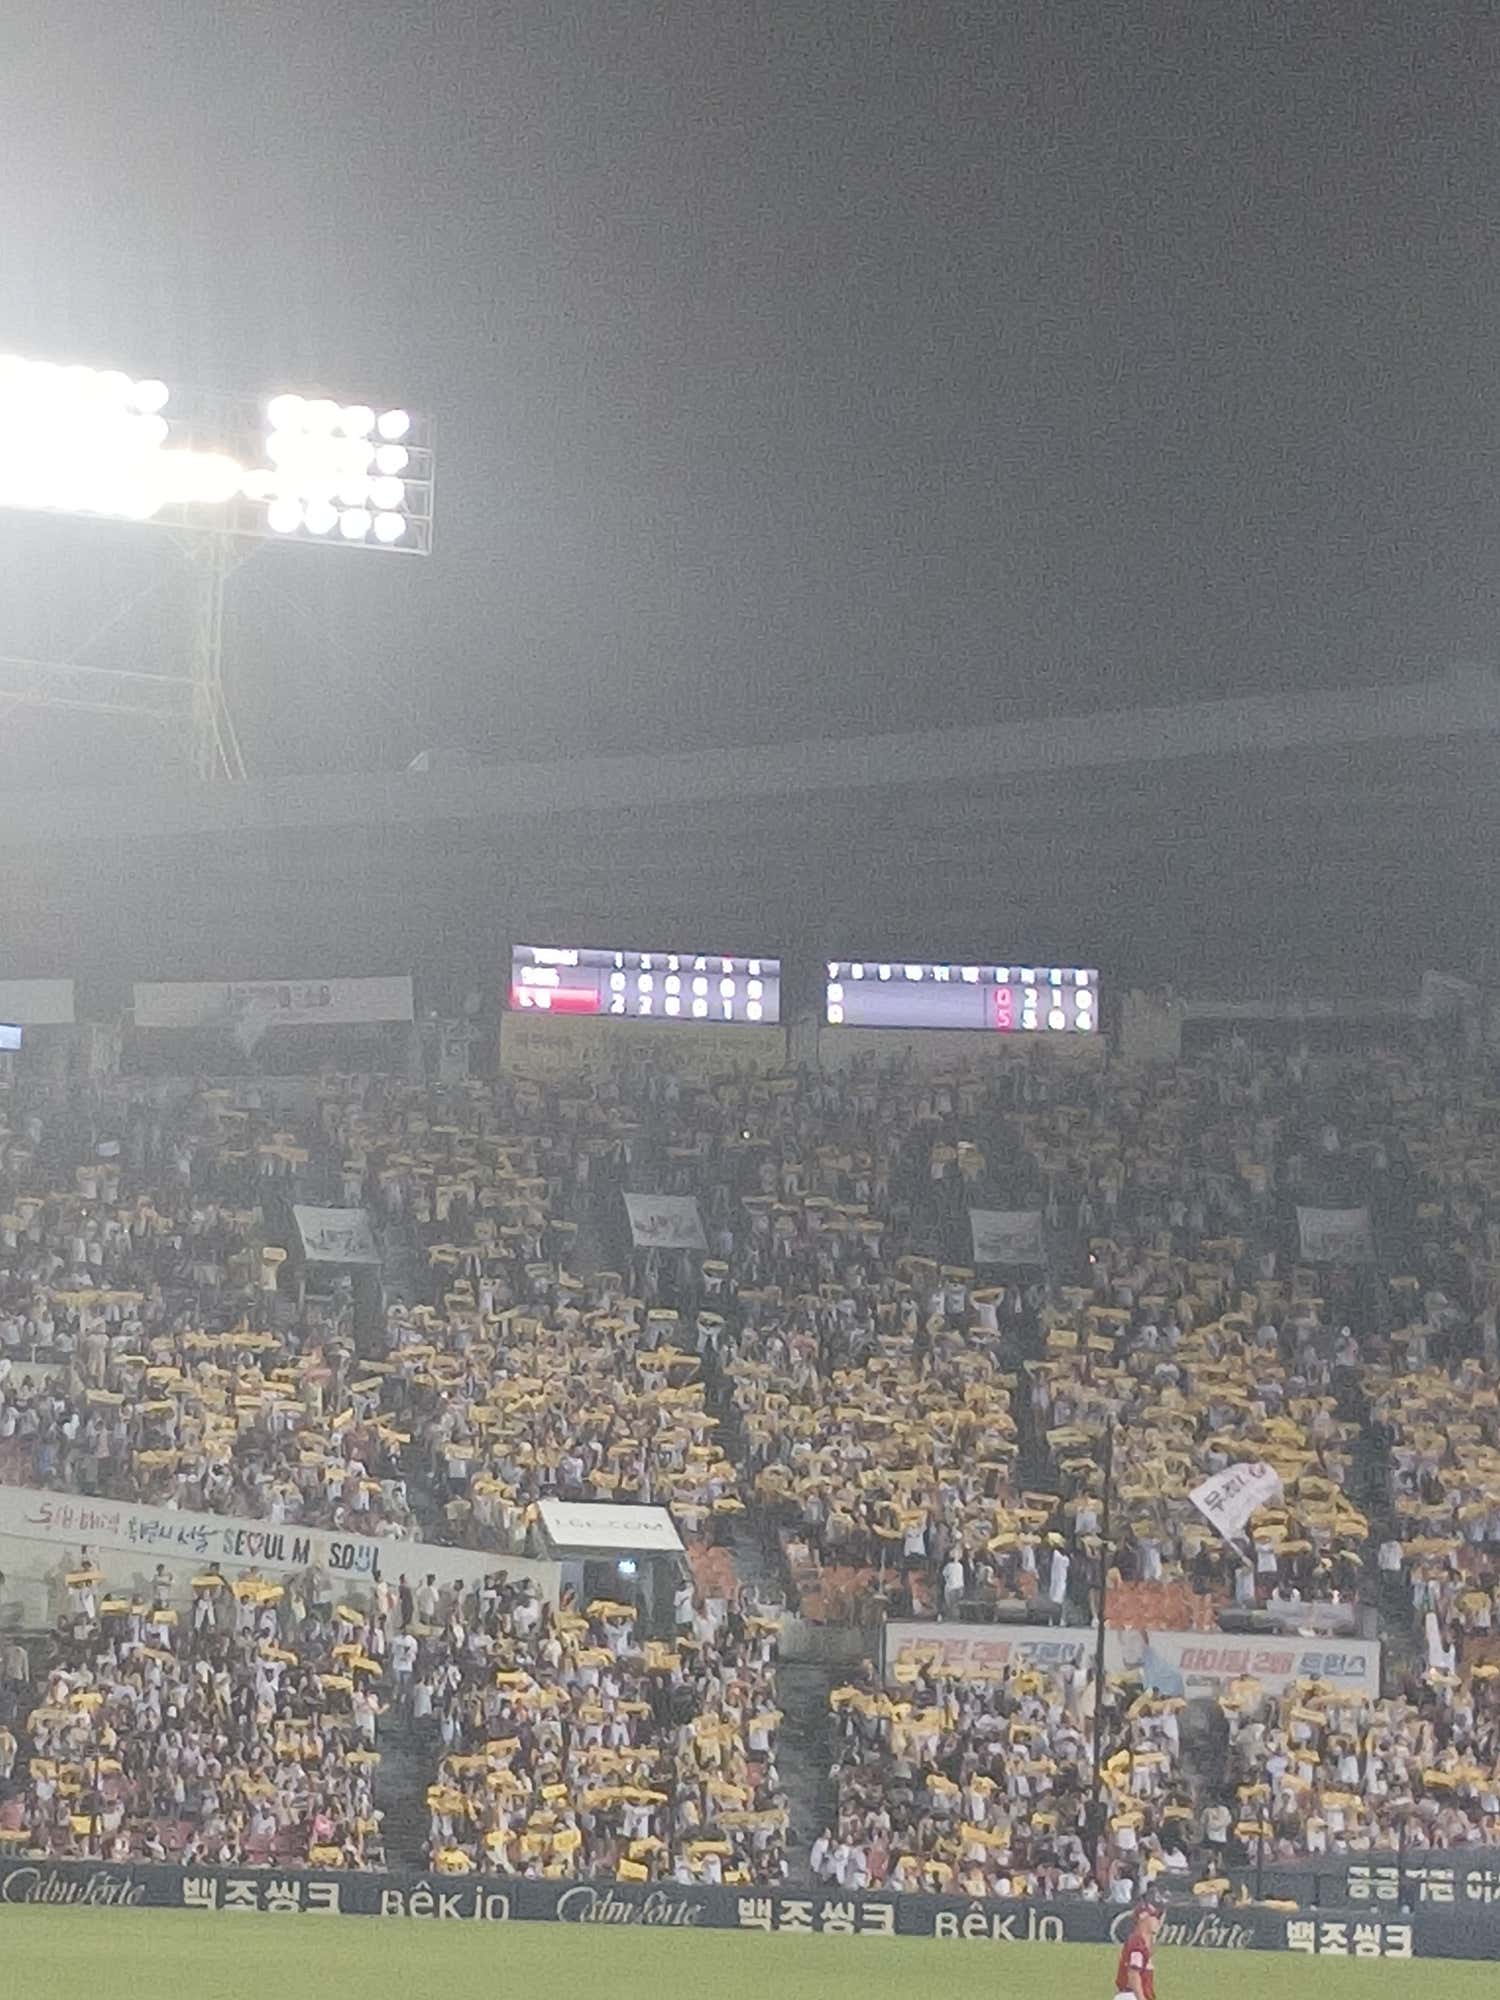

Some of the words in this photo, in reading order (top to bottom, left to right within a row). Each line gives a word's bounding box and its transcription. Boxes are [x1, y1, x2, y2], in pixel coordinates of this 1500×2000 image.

[723, 1000, 731, 1019] 1
[996, 989, 1010, 1005] 0
[1024, 989, 1037, 1007] 2
[1052, 990, 1061, 1006] 1
[997, 1010, 1010, 1027] 5
[183, 1877, 341, 1913] 백조씽크
[738, 1898, 894, 1936] 백조씽크
[1286, 1920, 1413, 1957] 백조씽크
